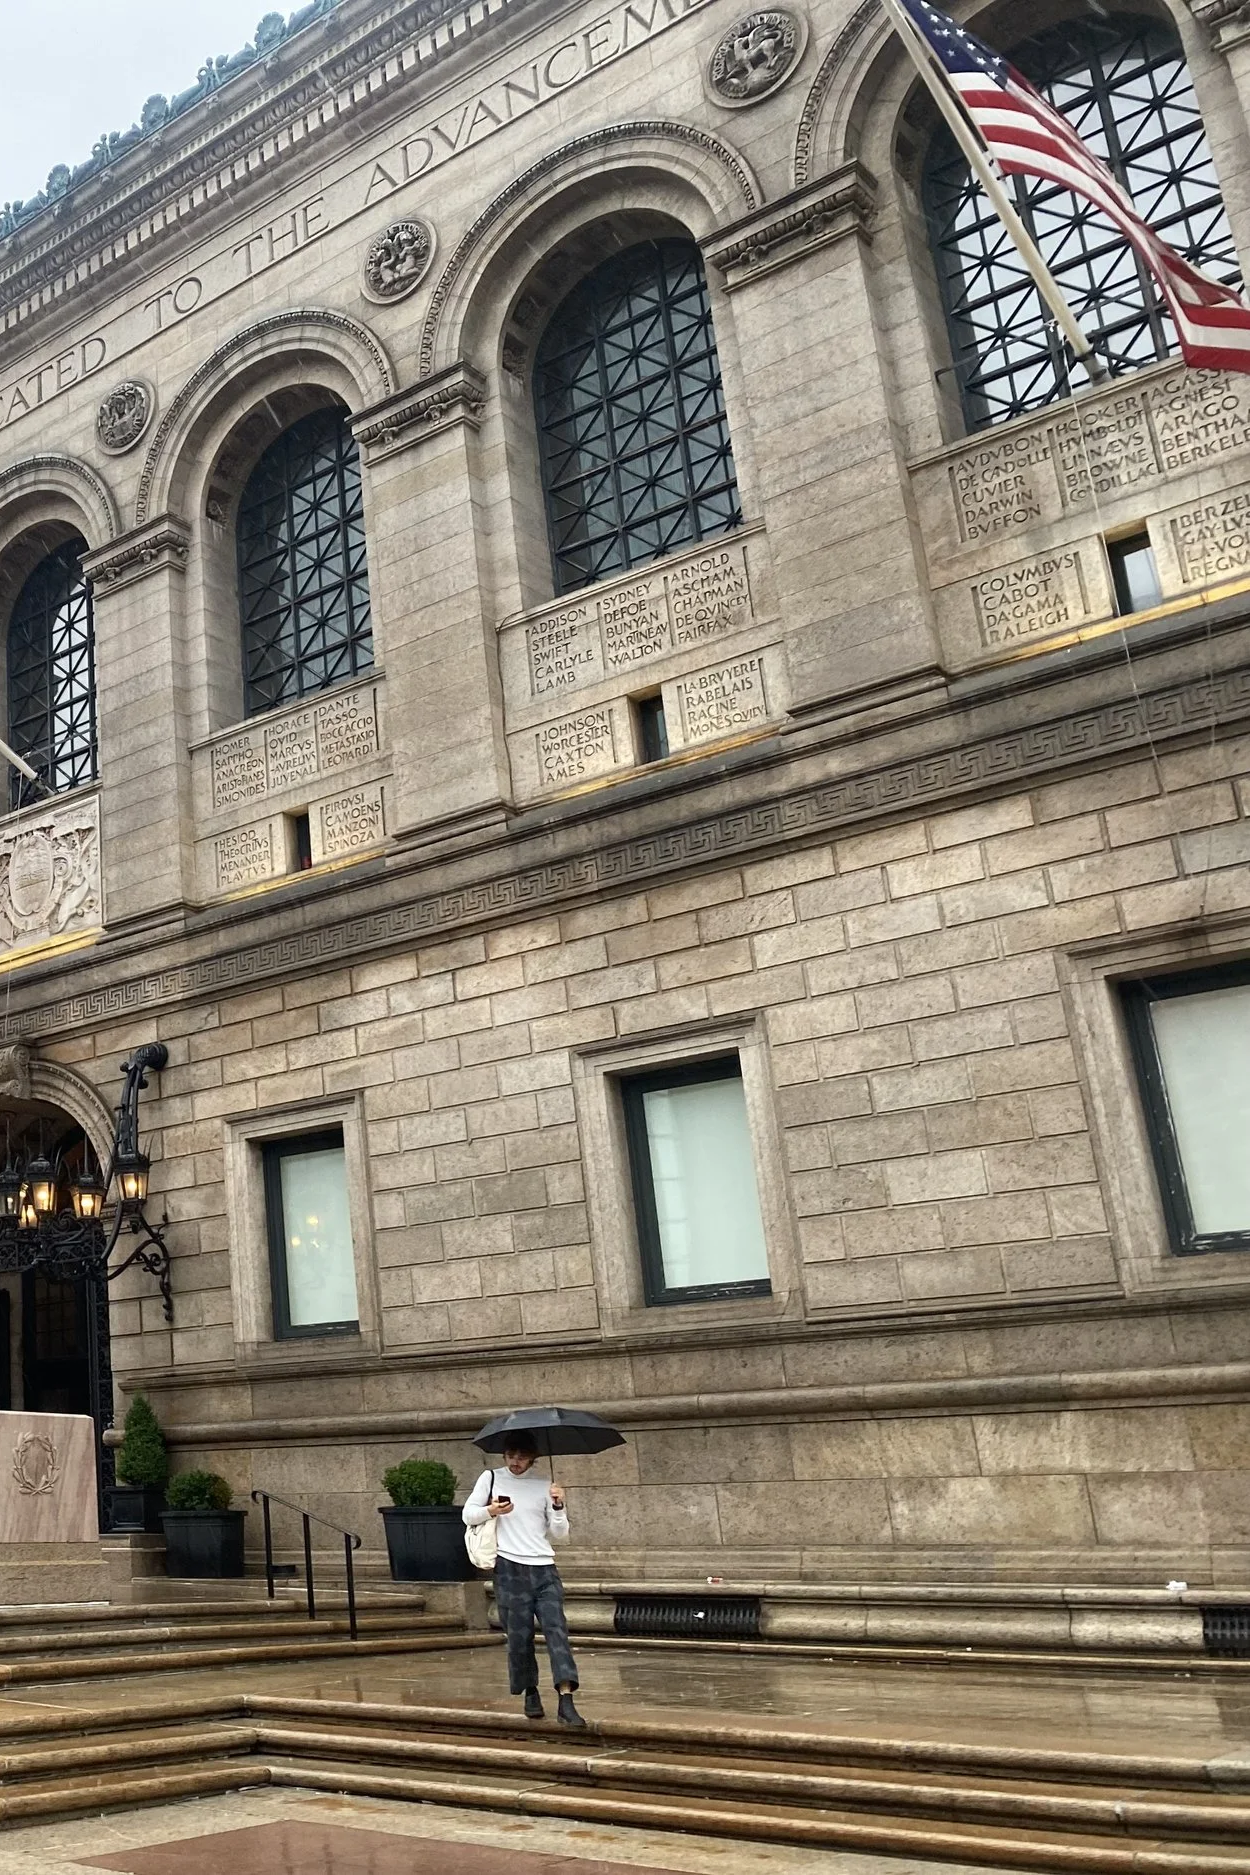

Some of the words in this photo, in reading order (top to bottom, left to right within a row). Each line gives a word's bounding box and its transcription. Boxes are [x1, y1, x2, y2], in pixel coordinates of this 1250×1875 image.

[144, 276, 203, 329] TO
[231, 196, 331, 275] THE
[363, 0, 692, 205] ADVANCEM
[1156, 378, 1231, 419] AGNESI
[1055, 396, 1139, 437] HOOKER
[1160, 395, 1240, 435] ARAGO
[1162, 408, 1250, 453] BENTHA
[956, 432, 1043, 475] AVDVBON
[1066, 448, 1149, 488] BROWNE
[962, 475, 1026, 507] CUVIER
[965, 488, 1034, 524] DARWIN
[967, 503, 1042, 540] BVFFON
[671, 552, 730, 585] ARNOLD
[980, 553, 1074, 596] COLVMBVS
[602, 583, 652, 611] SYDNEY
[672, 566, 736, 600] ASCHAM
[673, 577, 745, 614] CHAPMAN
[983, 578, 1052, 611] CABOT
[530, 606, 588, 637] ADDISON
[604, 599, 648, 625] DEFOE
[606, 610, 660, 639] BUNYAN
[989, 607, 1070, 644] RALEIGH
[531, 624, 579, 652] STEELE
[677, 614, 734, 644] FAIRFAX
[533, 641, 572, 666] SWIFT
[534, 649, 594, 680] CARLYLE
[609, 638, 663, 666] WALTON
[536, 671, 577, 694] LAMB
[685, 676, 754, 709] RABELAIS
[318, 693, 360, 717] DANTE
[319, 707, 358, 730] TASSO
[687, 697, 738, 725] RACINE
[268, 713, 311, 737] HORACE
[319, 716, 374, 744] BOCCACCIO
[541, 710, 606, 743] JOHNSON
[214, 736, 251, 758] HOMER
[269, 731, 298, 750] OVID
[321, 729, 375, 755] METASTASIO
[215, 748, 254, 770] SAPPHO
[321, 742, 373, 770] LEOPARDI
[544, 740, 605, 770] CAXTON
[215, 757, 265, 783] ANACREON
[270, 764, 317, 790] JUVENAL
[546, 761, 586, 785] AMES
[216, 781, 266, 808] SIMONIDES
[325, 800, 381, 827] CAMOENS
[326, 814, 379, 841] MANZONI
[219, 829, 256, 850] HESIOD
[327, 830, 376, 853] SPINOZA
[220, 850, 271, 873] MENANDER
